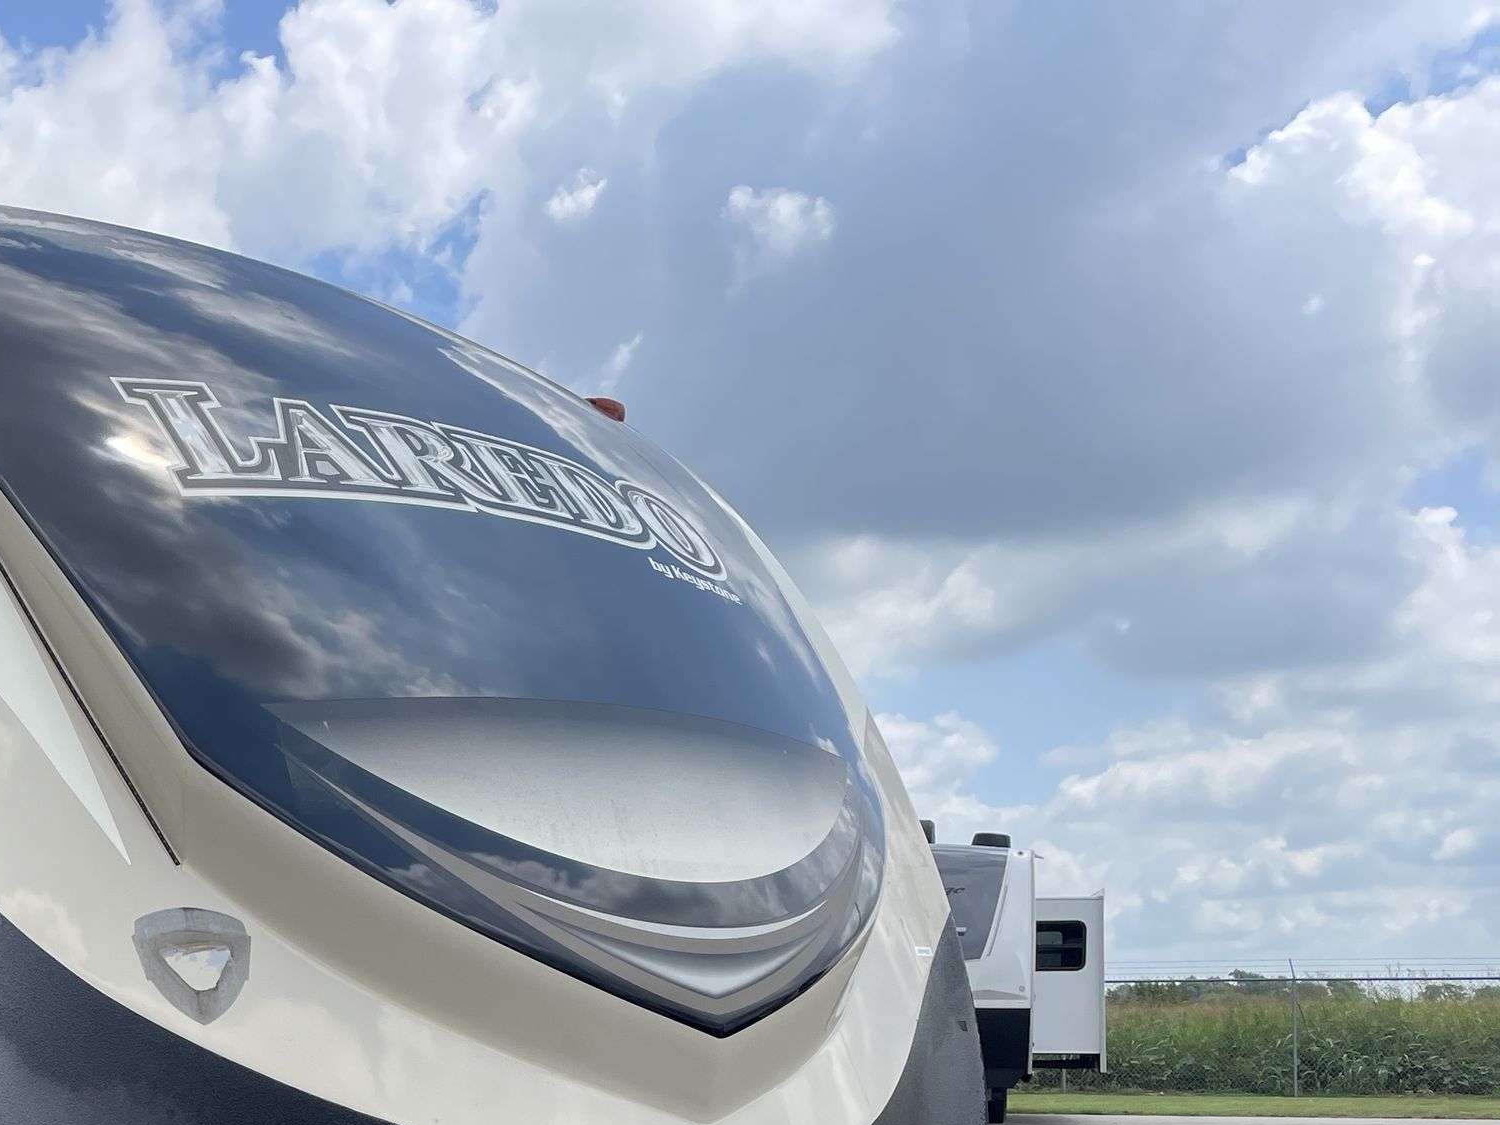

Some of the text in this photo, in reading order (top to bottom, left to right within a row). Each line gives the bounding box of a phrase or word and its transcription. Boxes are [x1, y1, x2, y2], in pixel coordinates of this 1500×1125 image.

[111, 377, 727, 581] LAREDO
[647, 556, 743, 606] by Keystone
